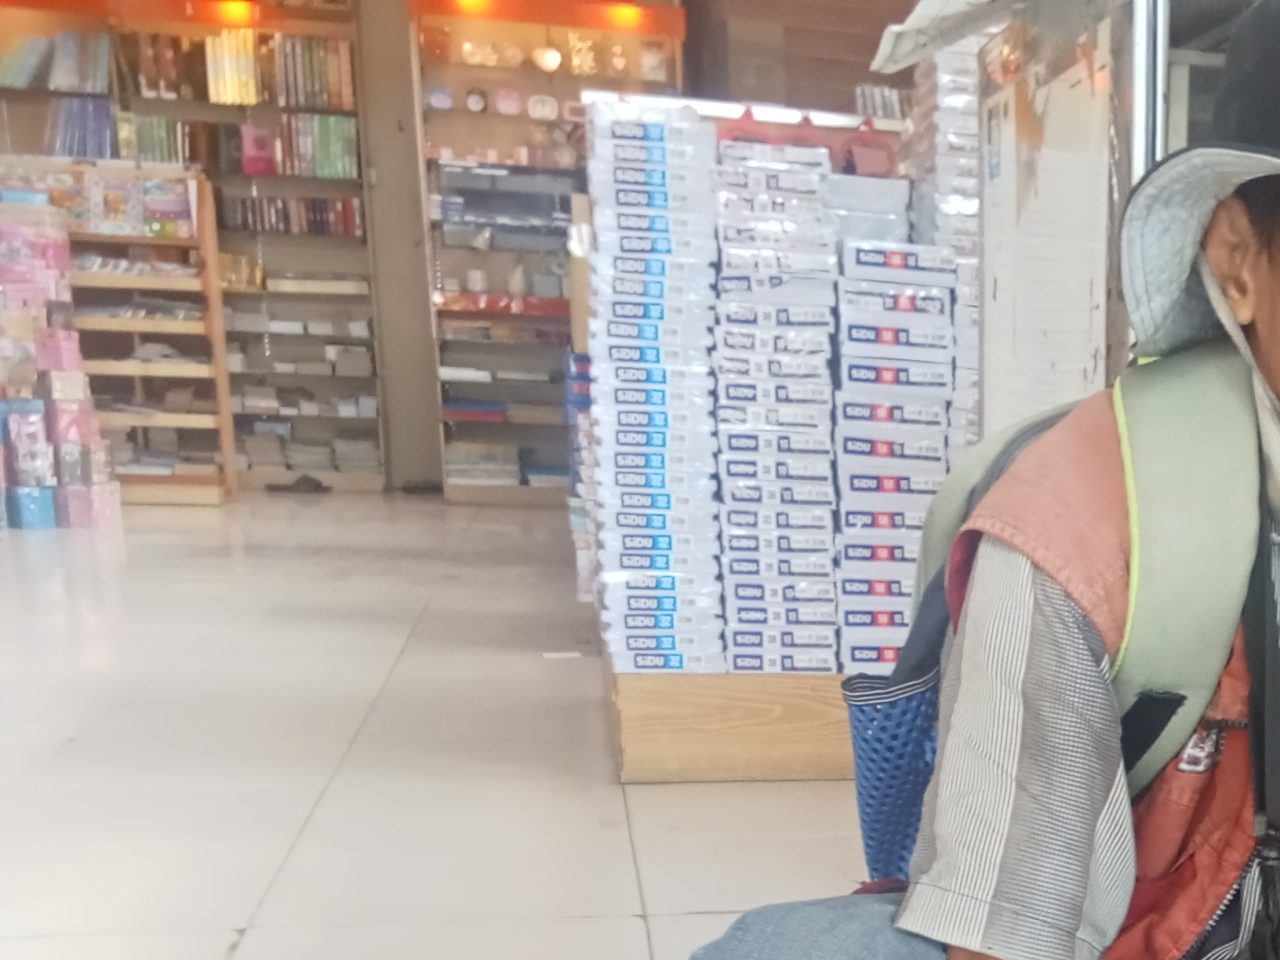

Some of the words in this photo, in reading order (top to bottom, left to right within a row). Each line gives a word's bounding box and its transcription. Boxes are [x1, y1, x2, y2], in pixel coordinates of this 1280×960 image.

[617, 390, 646, 403] SiDU
[619, 413, 648, 426] SiDU
[617, 433, 646, 445] SiDU
[617, 455, 645, 467] SiDU
[852, 478, 878, 490] SiDU
[622, 495, 651, 507] SiDU
[618, 515, 646, 527] SiDU
[624, 537, 652, 549] SiDU
[847, 547, 872, 558] SiDU
[621, 556, 650, 568] SiDU
[844, 582, 869, 593] SiDU
[629, 598, 657, 609] SiDU
[626, 616, 655, 627] SiDU
[847, 614, 872, 625] SiDU
[628, 637, 656, 649] SiDU
[636, 655, 664, 667] SiDU
[854, 650, 879, 660] SiDU
